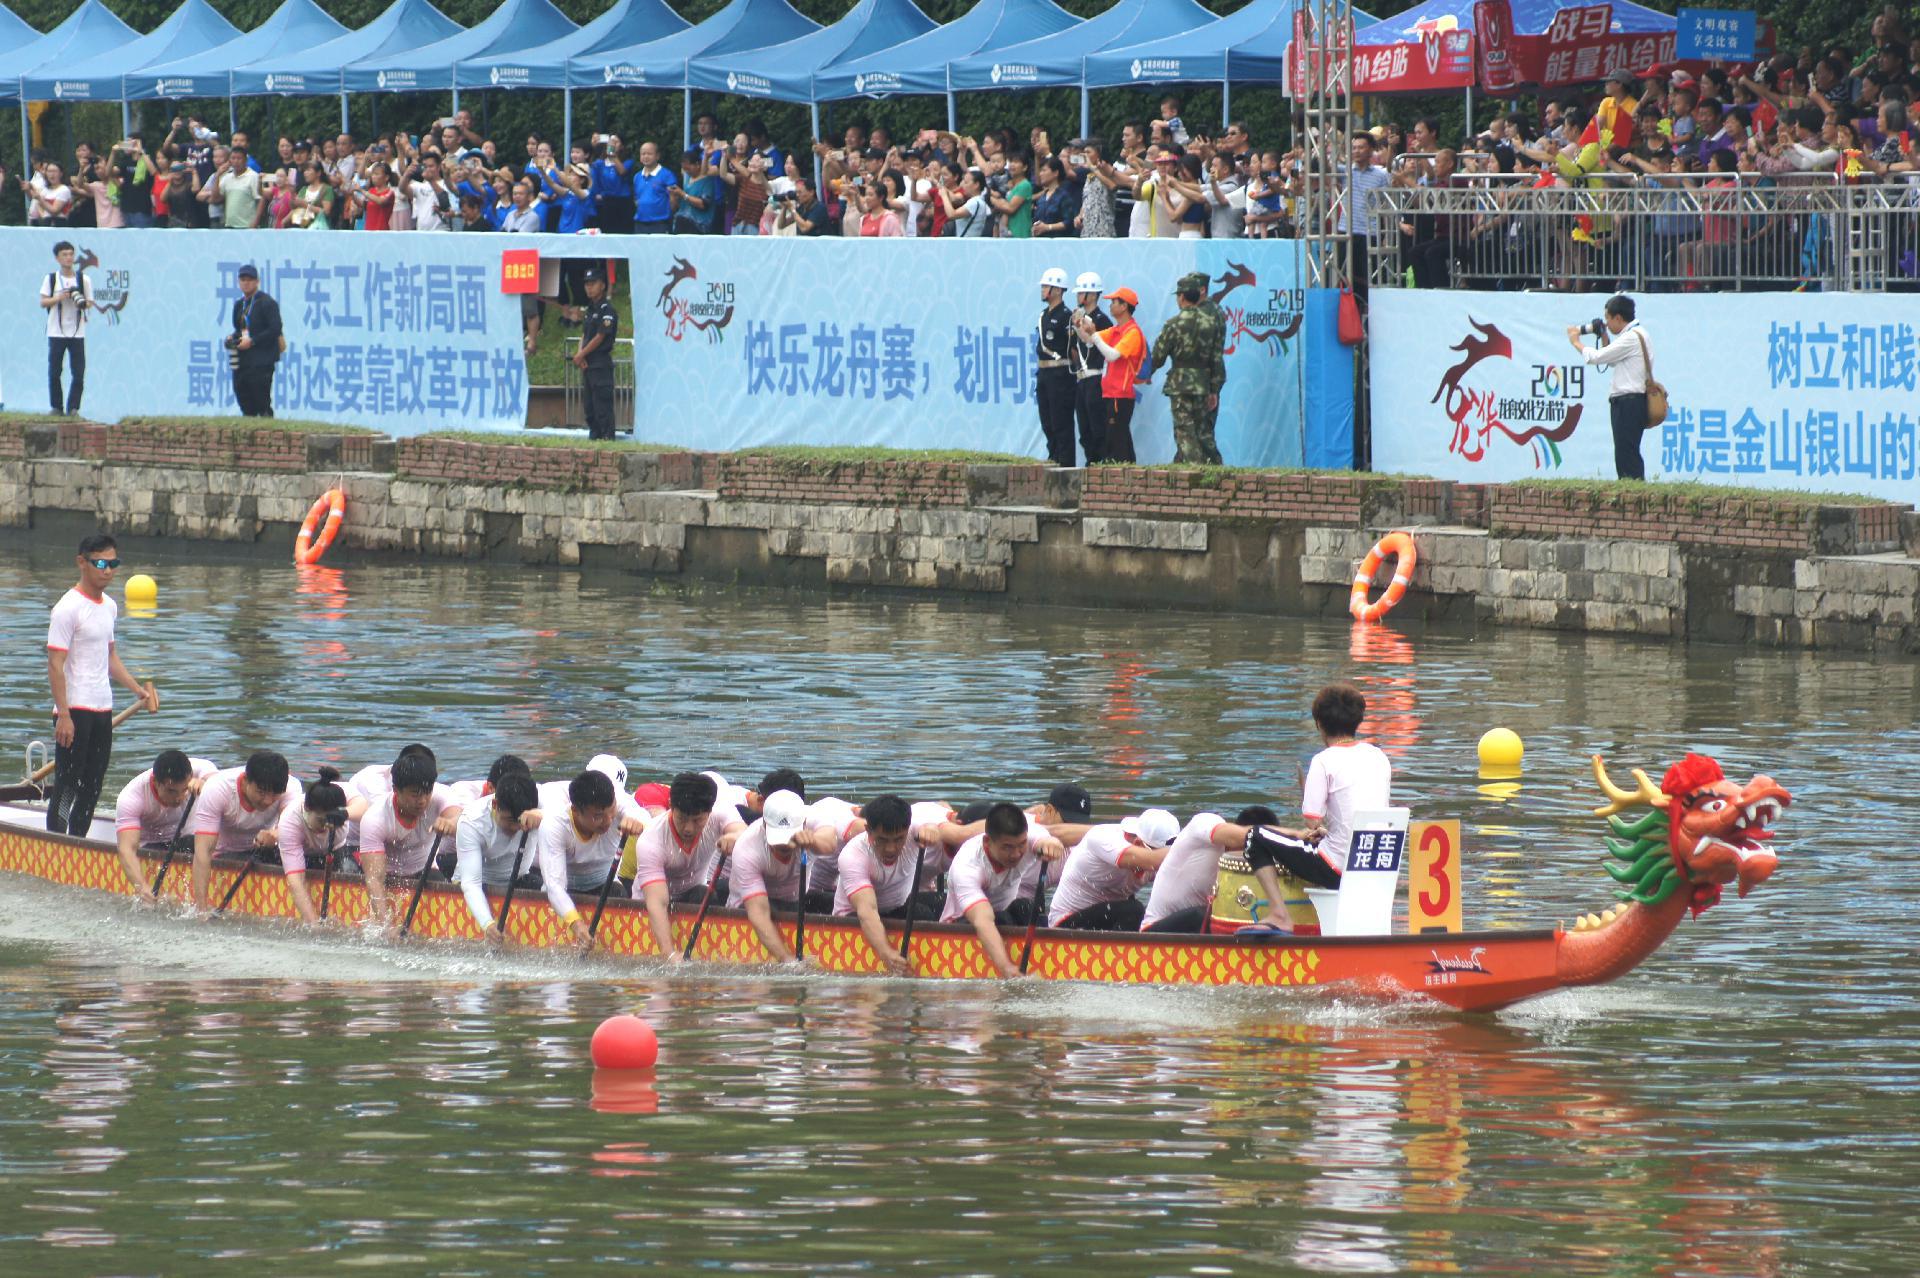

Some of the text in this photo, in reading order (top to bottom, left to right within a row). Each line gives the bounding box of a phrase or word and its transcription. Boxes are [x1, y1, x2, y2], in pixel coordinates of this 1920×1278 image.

[1551, 7, 1609, 44] 战马
[106, 269, 130, 289] 2019
[215, 258, 487, 335] 开广东工作新局面
[706, 282, 735, 303] 2019
[1268, 288, 1305, 311] 2019
[187, 338, 525, 419] 最根的还要靠改革开放
[743, 320, 1040, 404] 快乐龙舟赛，划向
[1531, 365, 1585, 399] 2019
[1768, 320, 1920, 393] 树立和践
[1498, 398, 1565, 422] 龙舟文化艺术节
[1661, 406, 1920, 480] 就是金山银山的
[1418, 824, 1451, 917] 3
